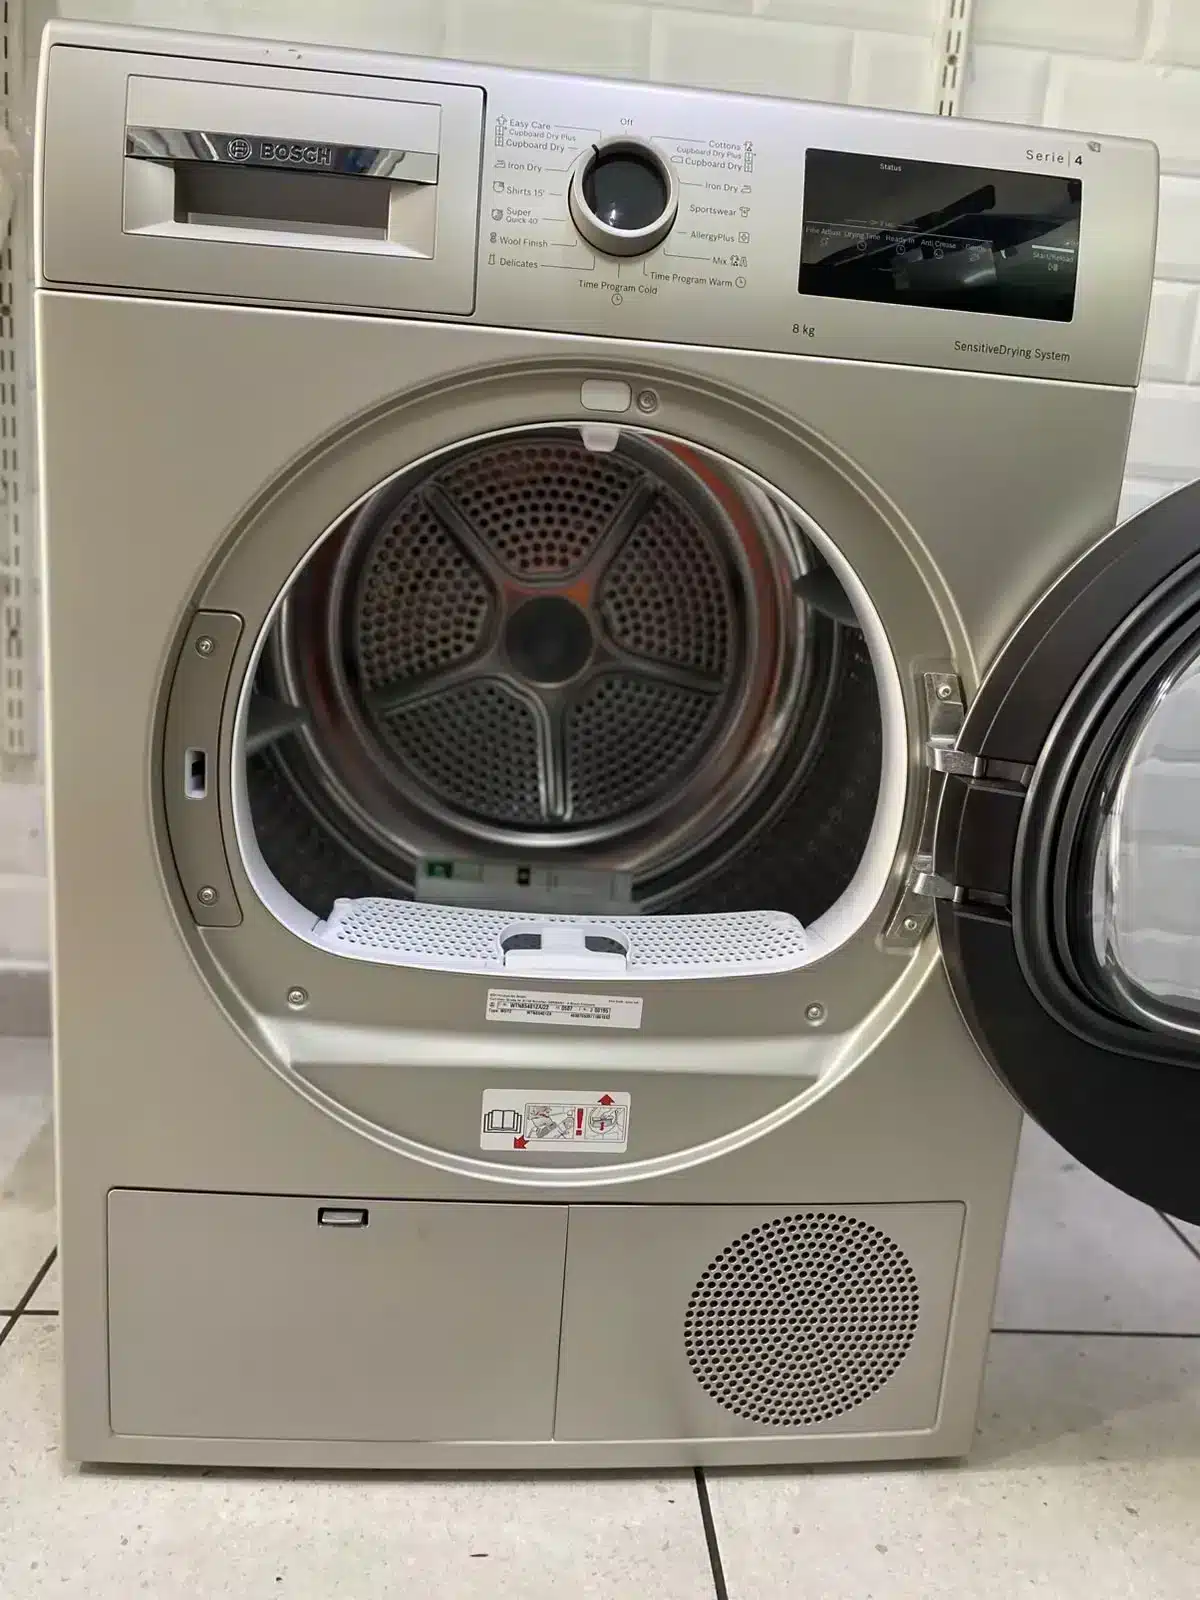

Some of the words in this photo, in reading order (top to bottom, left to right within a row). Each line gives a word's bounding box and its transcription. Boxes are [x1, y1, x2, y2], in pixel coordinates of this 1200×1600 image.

[509, 119, 529, 129] Easy
[531, 120, 551, 130] Care
[620, 118, 633, 127] Off
[509, 129, 545, 139] Cupboard
[505, 139, 548, 151] Cupboard
[550, 143, 565, 153] Dry
[676, 146, 711, 156] Cupboard
[708, 140, 741, 151] Cottons
[260, 142, 332, 165] BOSCH
[1026, 150, 1064, 163] Serie
[1074, 156, 1083, 165] 4
[507, 161, 525, 171] Iron
[527, 162, 543, 173] Dry
[685, 158, 726, 169] Cupboard
[727, 162, 743, 172] Dry
[879, 163, 902, 172] Status
[506, 186, 531, 196] Shirts
[705, 182, 722, 190] Iron
[723, 184, 739, 193] Dry
[506, 207, 532, 218] Super
[690, 204, 737, 217] Sportswear
[505, 216, 526, 224] Quick
[500, 236, 521, 246] Wool
[523, 238, 548, 248] Finish
[690, 230, 735, 243] AllergyPlus
[500, 257, 538, 269] Delicates
[712, 256, 727, 265] Mix
[650, 271, 670, 281] Time
[672, 274, 707, 285] Program
[708, 278, 733, 288] Warm
[578, 279, 599, 289] Time
[601, 282, 636, 293] Program
[638, 285, 658, 295] Cold
[792, 324, 799, 334] 8
[802, 324, 815, 337] kg
[954, 340, 1031, 359] SensitiveDrying
[1035, 348, 1071, 363] System
